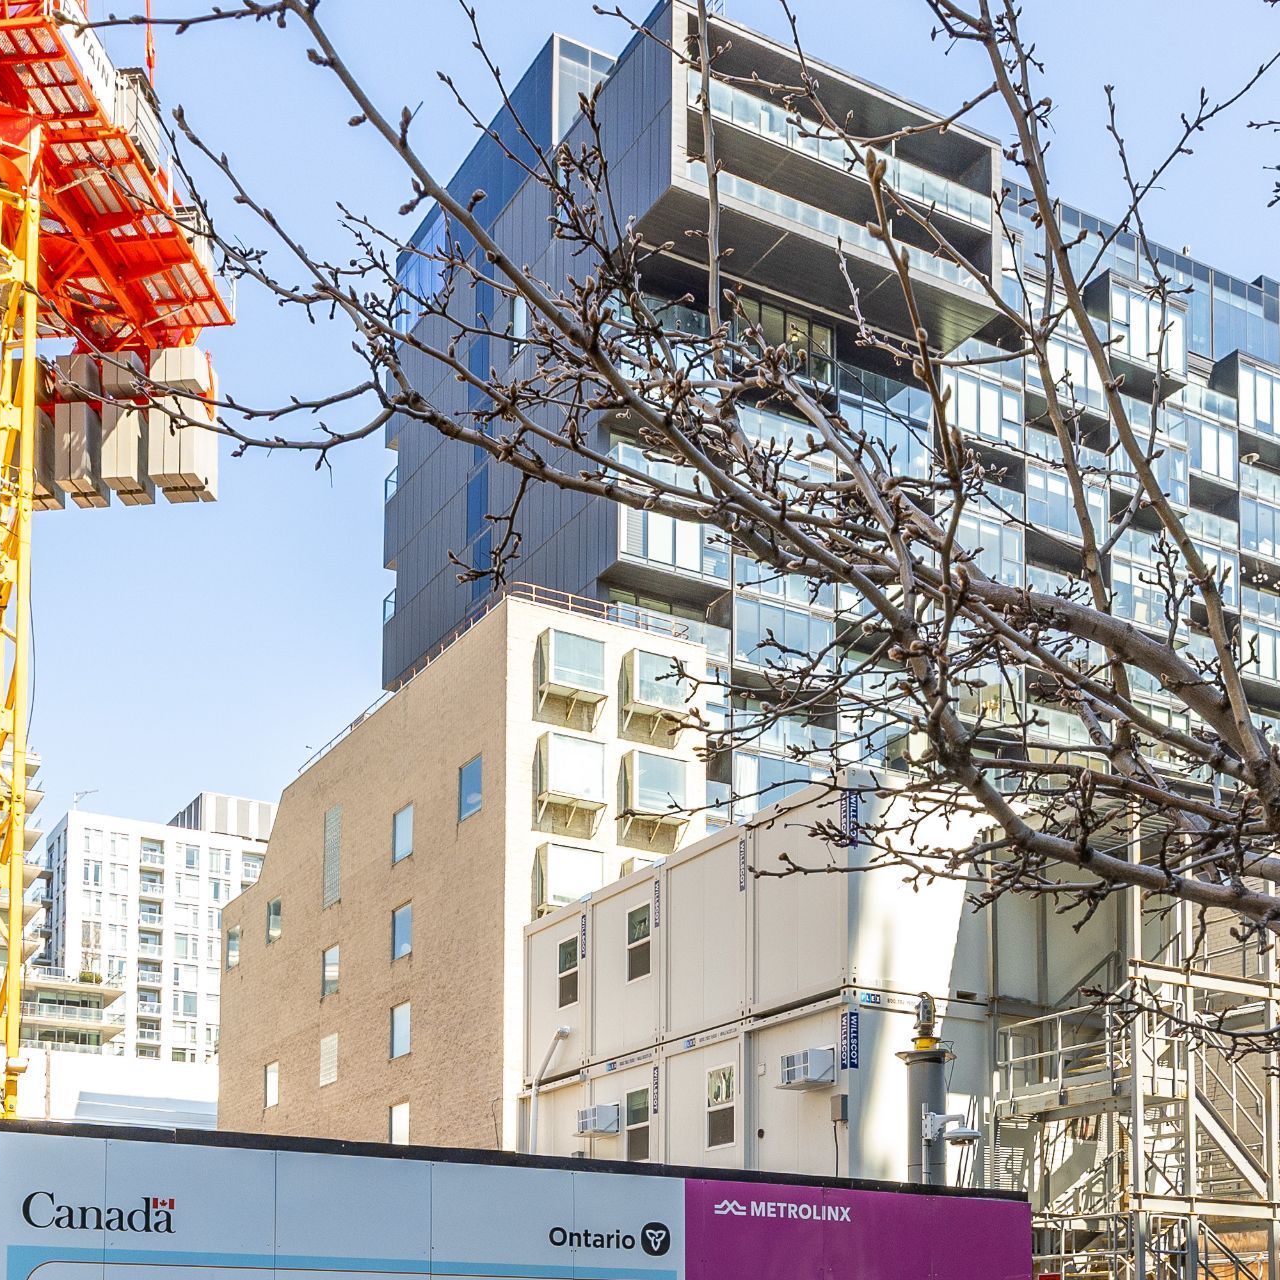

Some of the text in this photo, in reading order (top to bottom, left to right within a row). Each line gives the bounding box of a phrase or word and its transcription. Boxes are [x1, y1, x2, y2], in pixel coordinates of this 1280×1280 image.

[850, 1015, 858, 1065] WILLSCOT
[22, 1191, 176, 1234] Canada
[750, 1201, 851, 1222] METROLINX
[549, 1226, 636, 1250] Ontario
